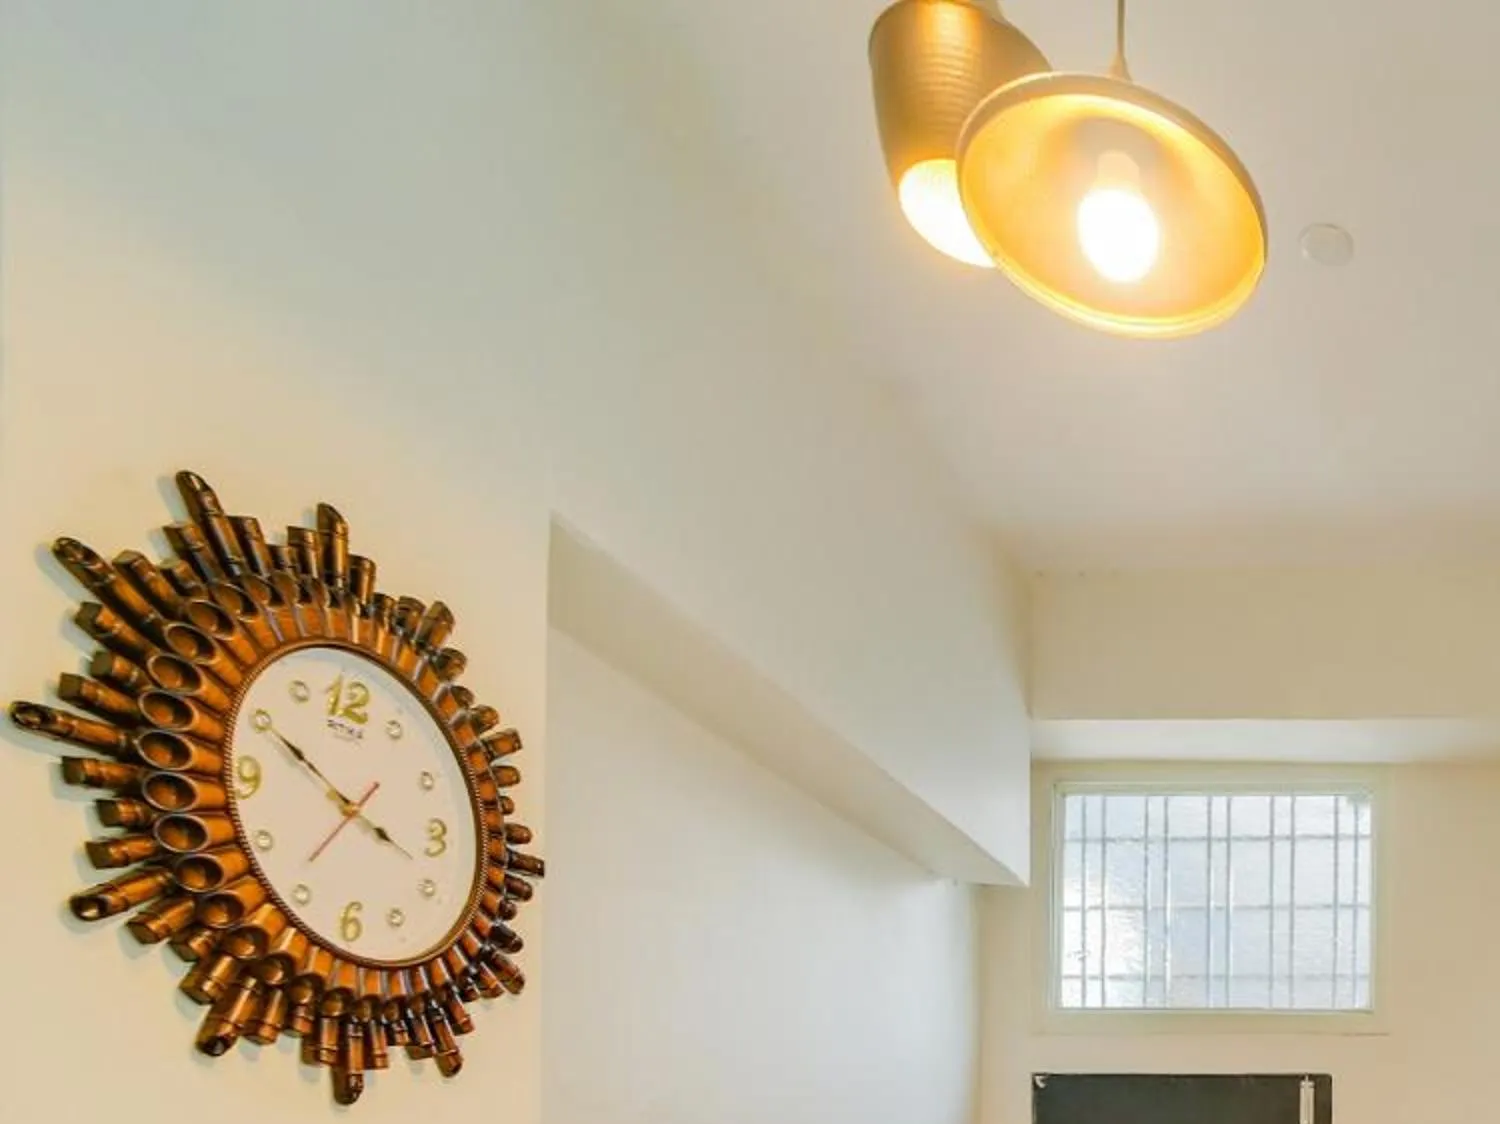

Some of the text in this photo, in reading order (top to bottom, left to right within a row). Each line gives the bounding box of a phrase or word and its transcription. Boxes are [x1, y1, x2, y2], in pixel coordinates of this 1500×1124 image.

[325, 674, 369, 724] 12
[234, 755, 262, 800] 9
[425, 819, 447, 857] 3
[340, 901, 363, 942] 6
